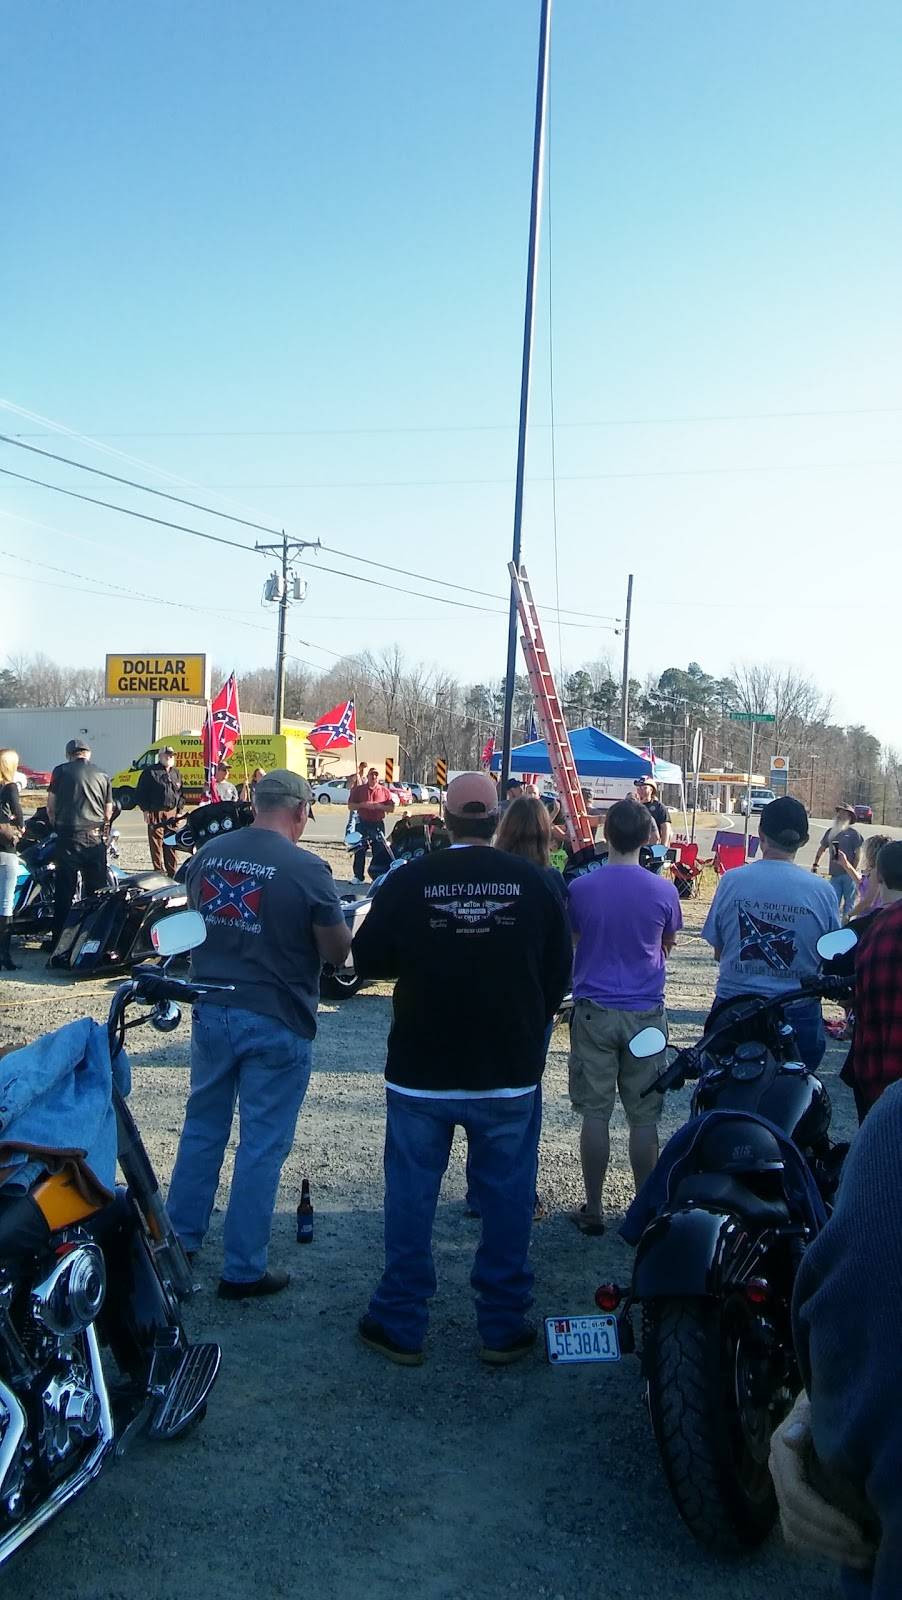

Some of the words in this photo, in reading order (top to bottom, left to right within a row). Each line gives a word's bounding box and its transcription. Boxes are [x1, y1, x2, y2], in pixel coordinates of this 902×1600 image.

[122, 660, 186, 675] DOLLAR
[117, 677, 190, 692] GENERAL
[176, 751, 203, 760] HURS
[206, 857, 217, 867] AM
[217, 857, 223, 867] A
[223, 859, 277, 879] CONFEDERATE
[424, 883, 520, 898] HARLEY-DAVIDSON
[734, 899, 751, 908] IT'S
[763, 902, 813, 915] SOUTHERN
[760, 911, 796, 923] THANG
